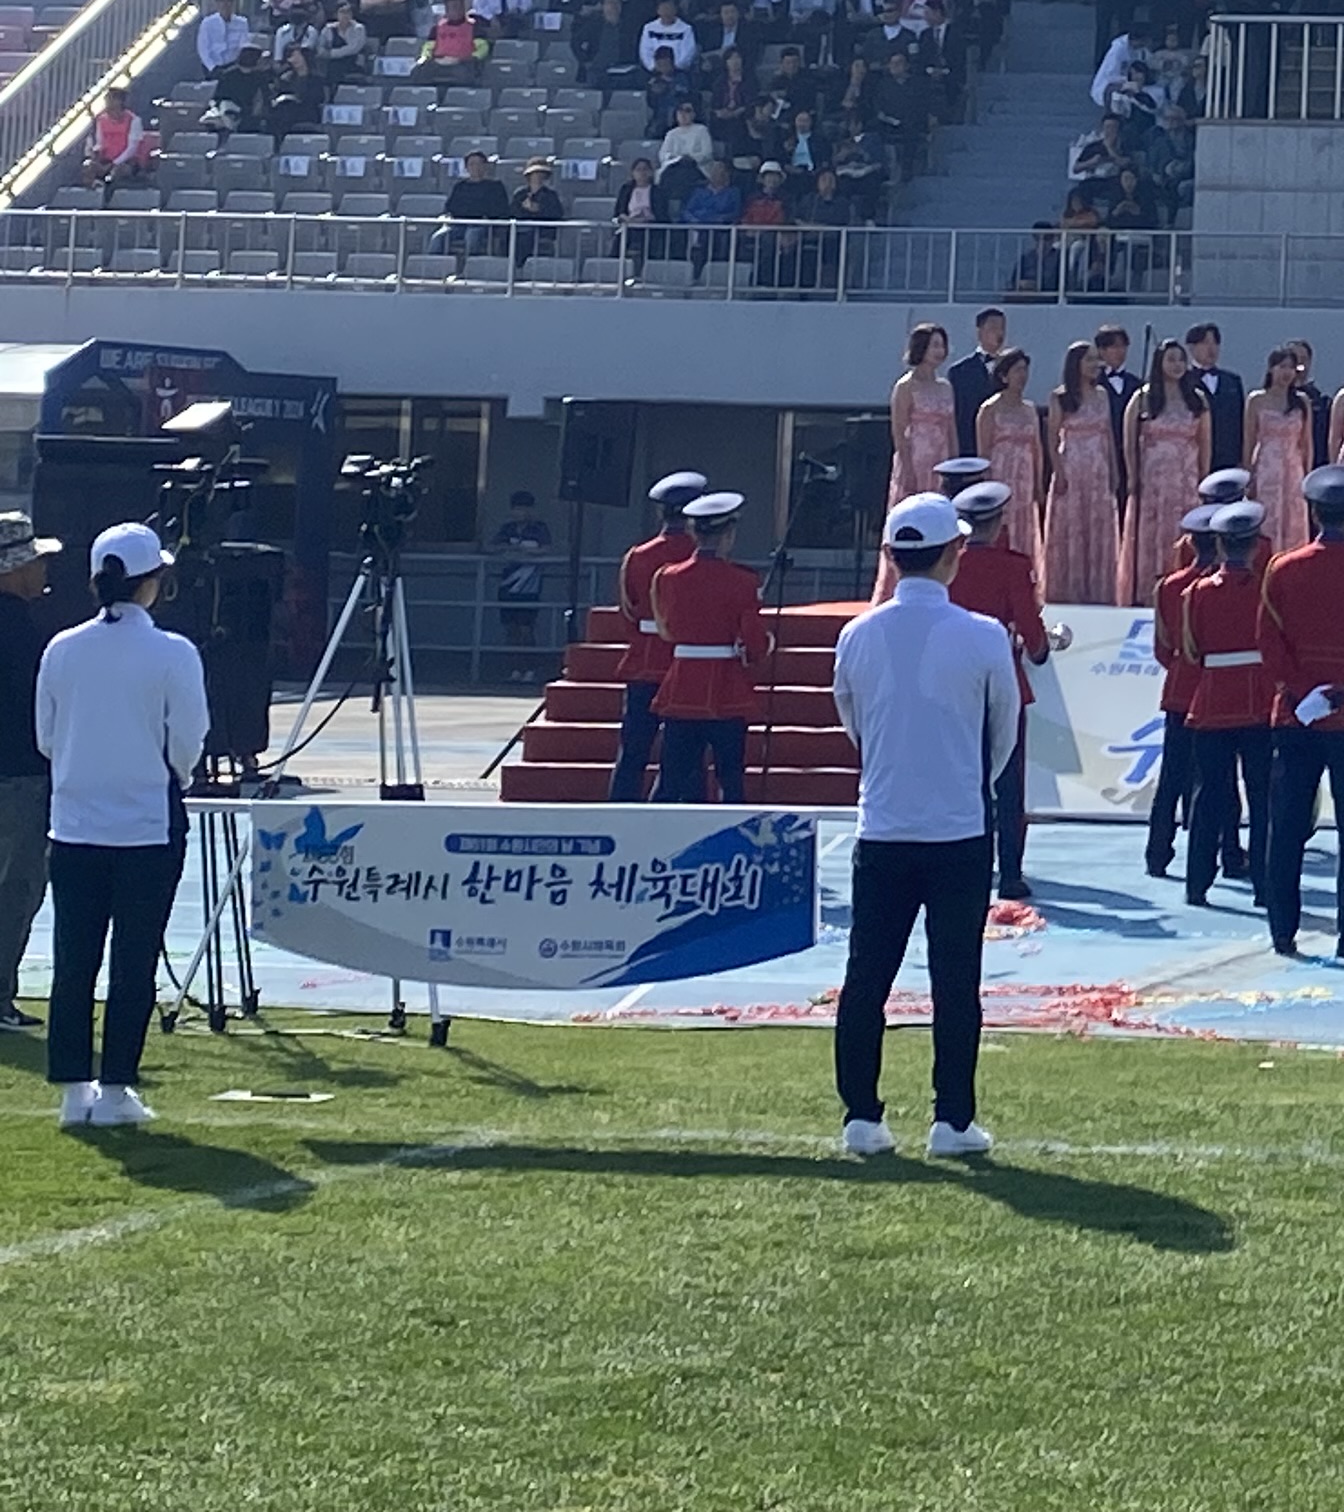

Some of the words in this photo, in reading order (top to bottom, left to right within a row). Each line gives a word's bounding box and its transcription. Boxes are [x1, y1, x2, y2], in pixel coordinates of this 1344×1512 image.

[1089, 662, 1162, 676] 수원특례
[302, 863, 449, 903] 수원특례시
[461, 859, 573, 906] 한마음
[588, 855, 762, 913] 체육대회
